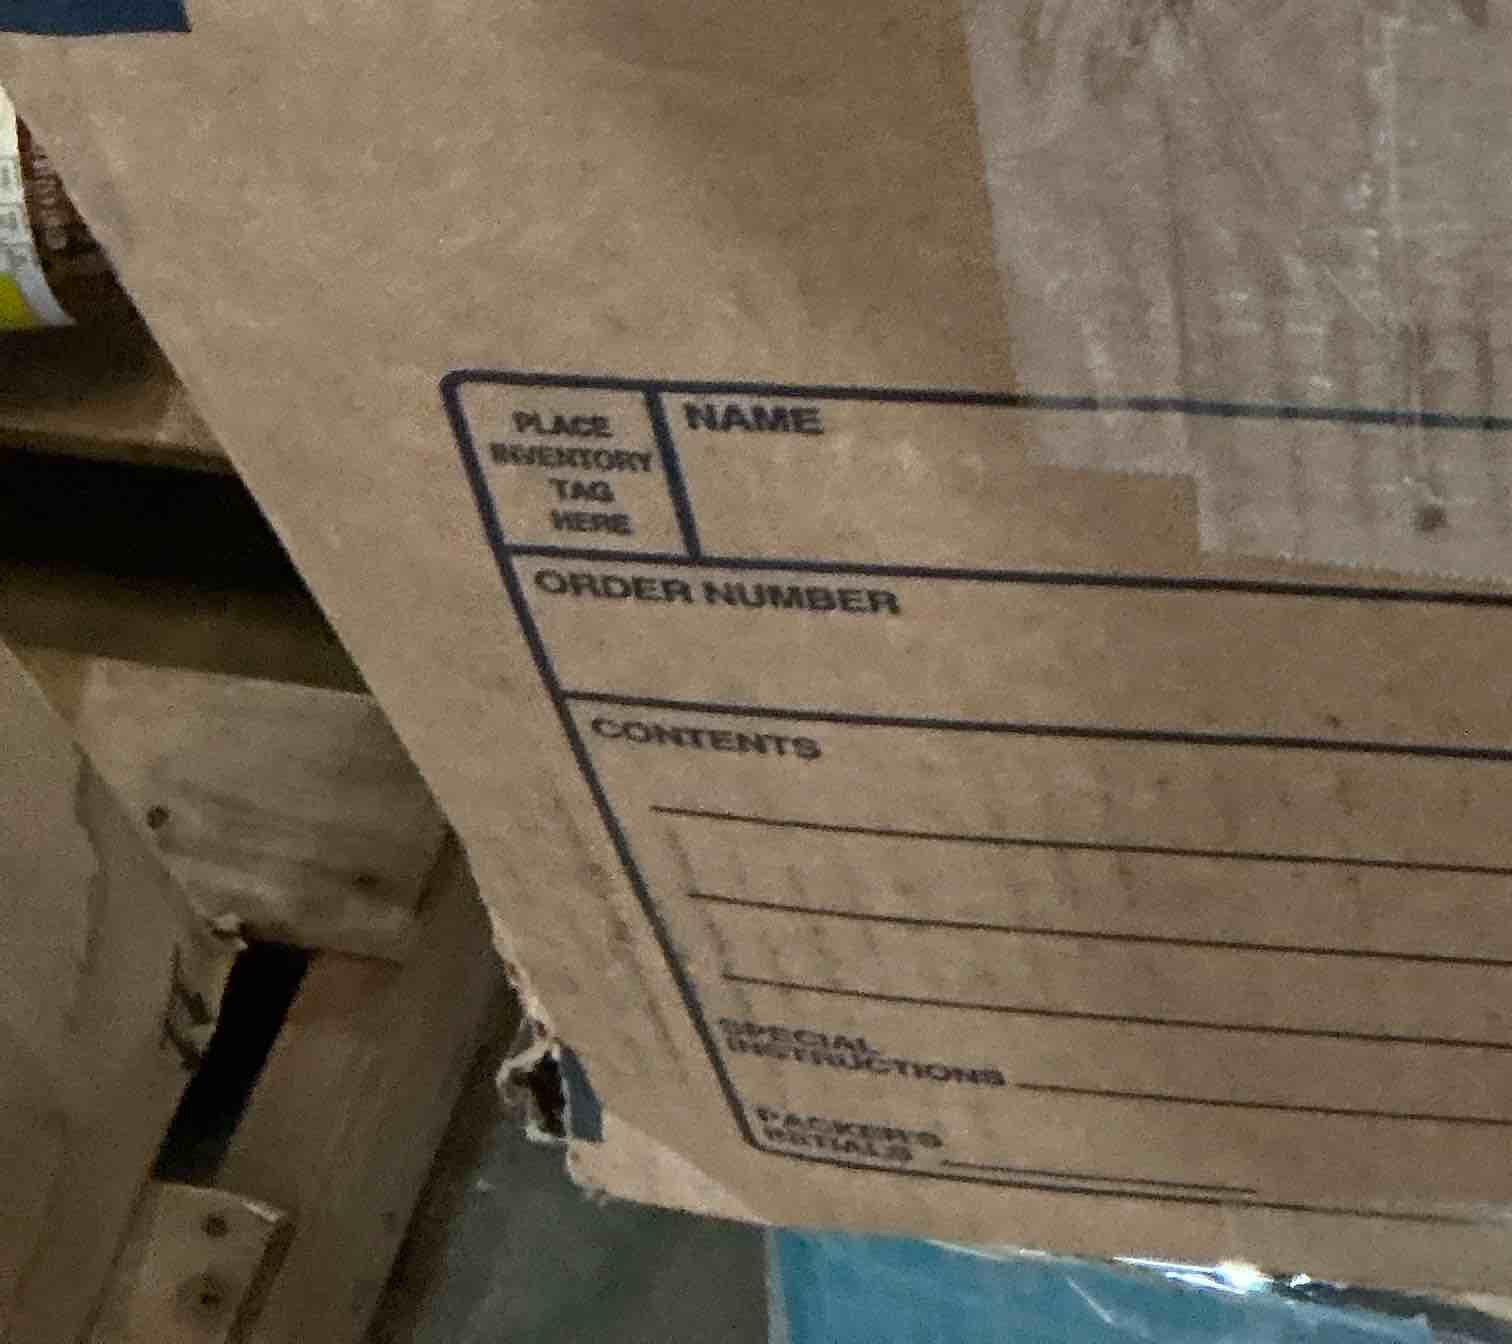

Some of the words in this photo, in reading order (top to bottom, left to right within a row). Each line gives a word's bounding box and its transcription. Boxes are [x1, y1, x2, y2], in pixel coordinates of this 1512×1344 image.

[512, 410, 613, 439] PLACE
[684, 401, 825, 435] NAME
[489, 441, 653, 472] INVENTORY
[549, 476, 616, 502] TAG
[550, 509, 634, 536] HERE
[534, 568, 694, 606] ORDER
[703, 585, 901, 616] NUMBER
[592, 717, 822, 761] CONTENTS
[719, 1018, 880, 1056] SPECIAL
[727, 1037, 1006, 1087] INSTRUCTIONS
